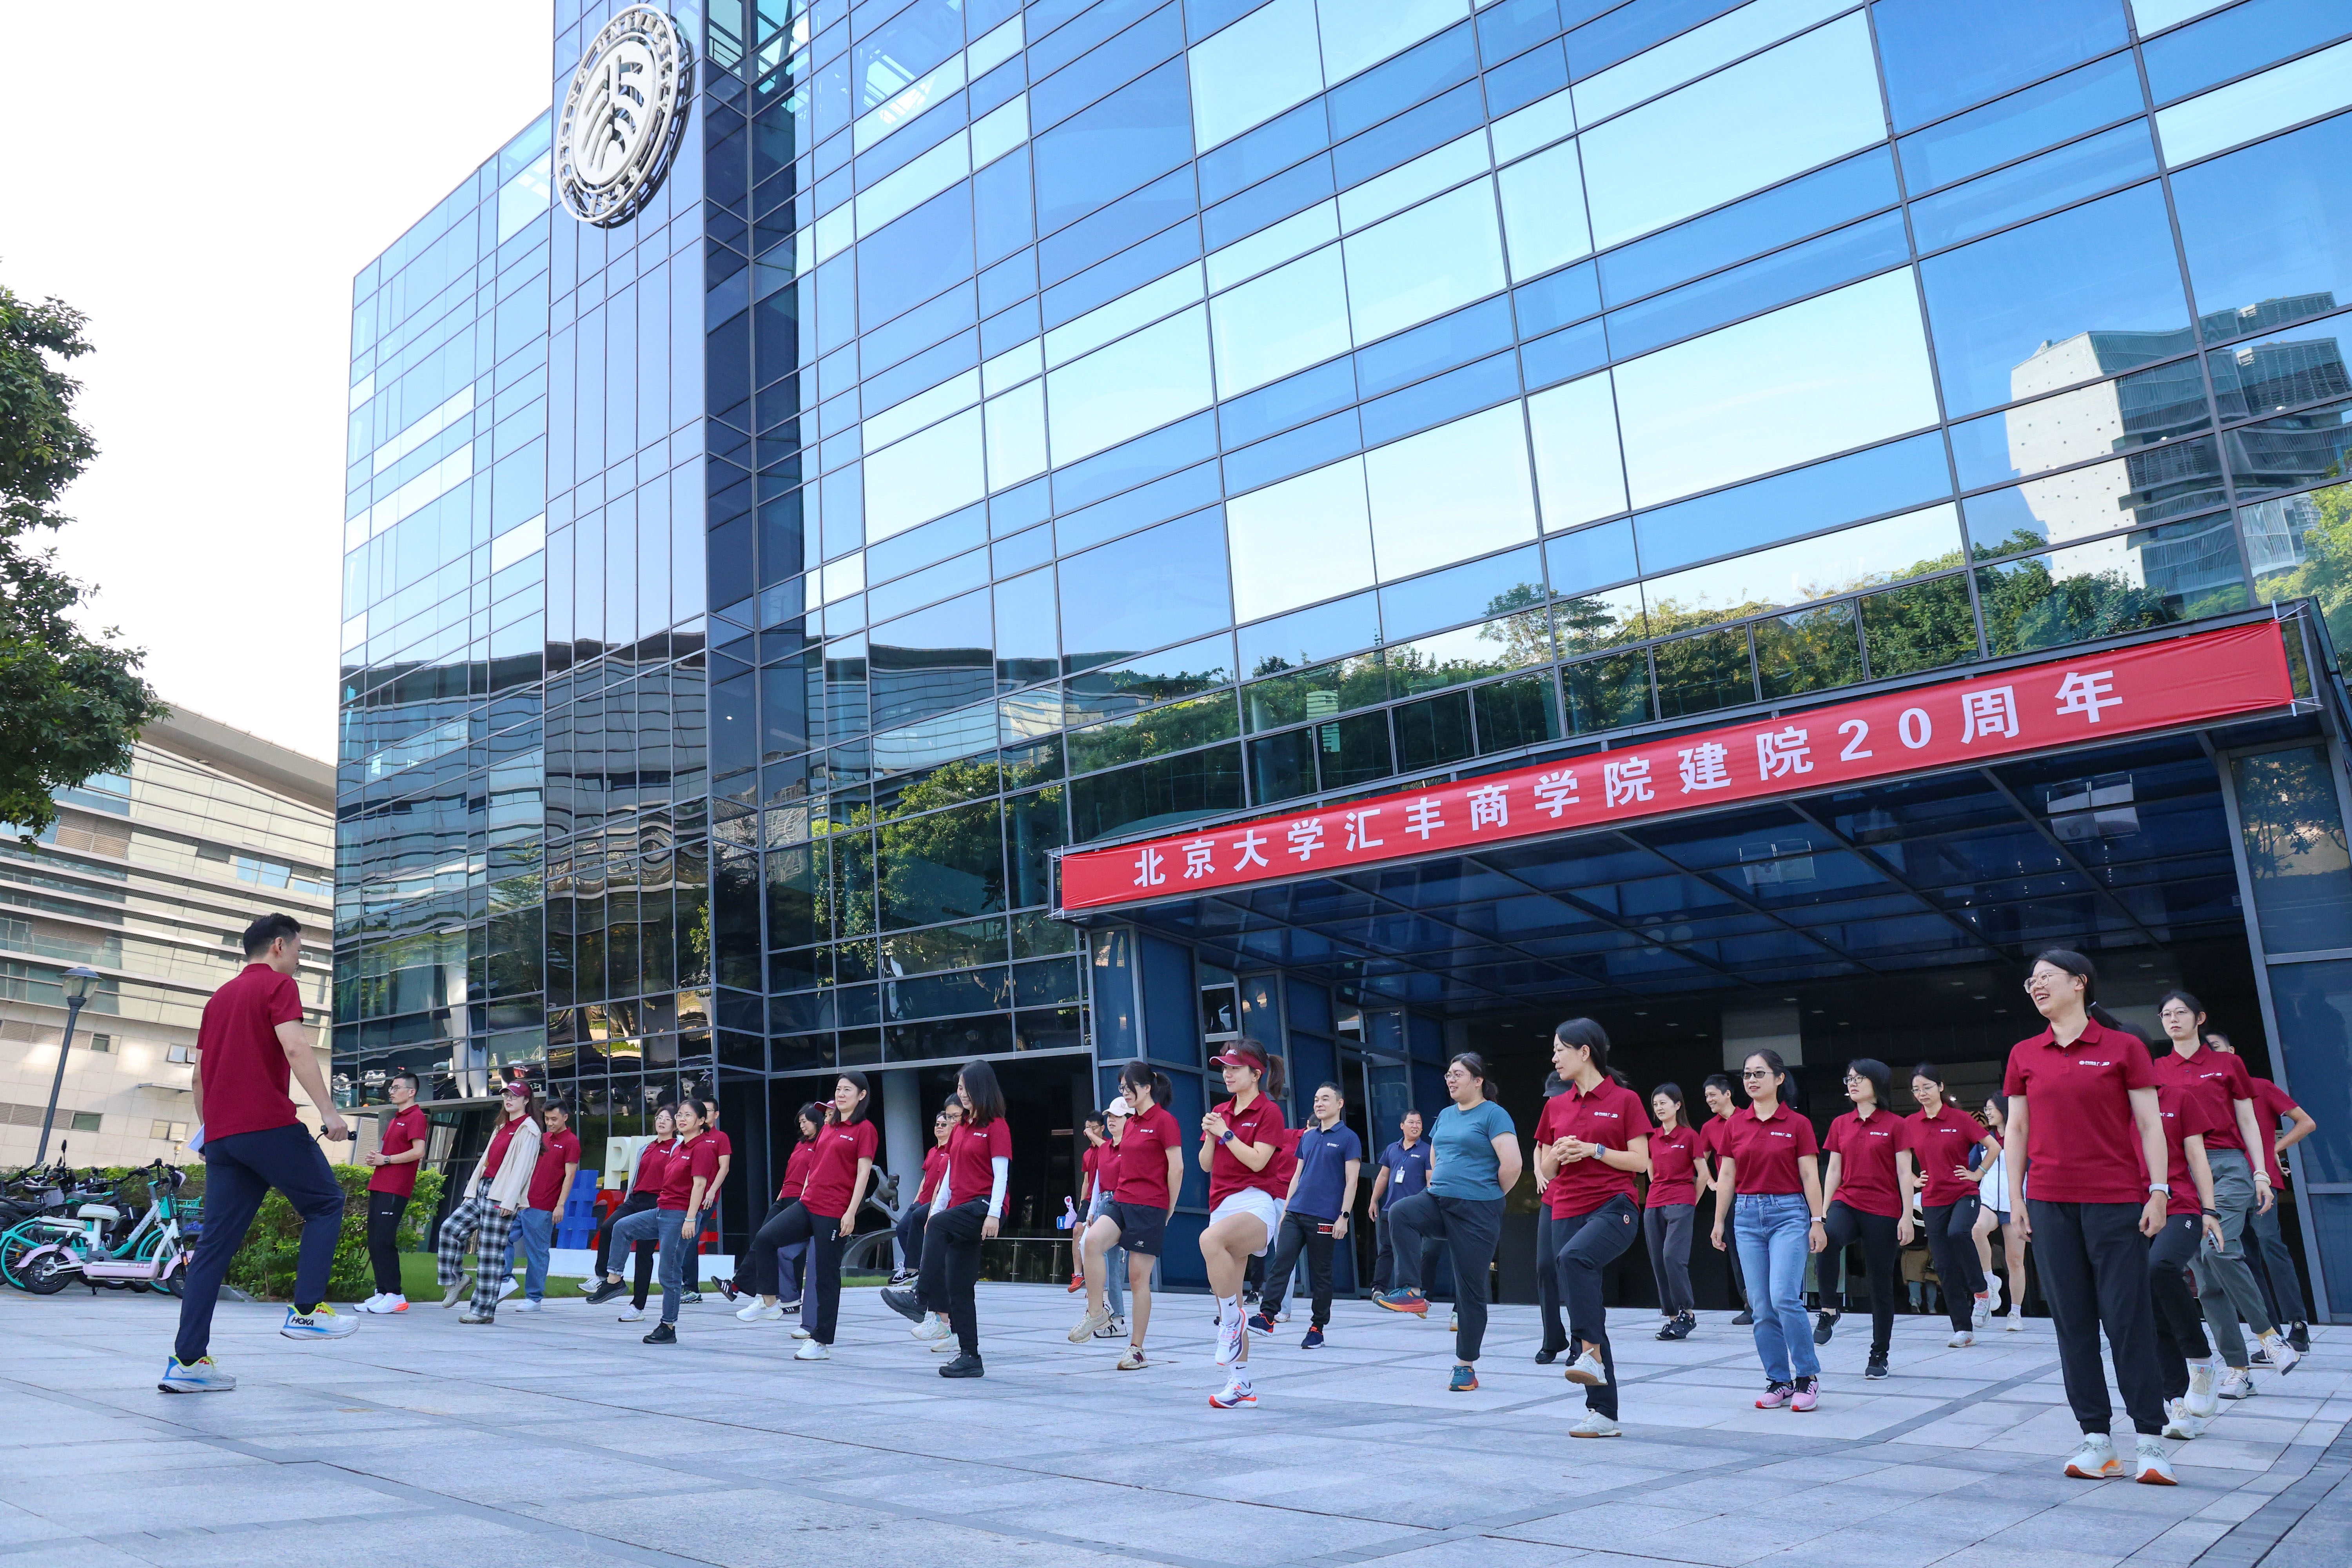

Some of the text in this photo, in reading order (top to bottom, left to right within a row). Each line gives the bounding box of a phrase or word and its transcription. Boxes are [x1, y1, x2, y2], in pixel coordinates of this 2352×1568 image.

[595, 11, 673, 114] UNIVERSITY
[559, 67, 589, 190] PEKING
[588, 165, 641, 215] 1898
[1133, 670, 2123, 887] 北京大学汇丰商学院建院20周年
[291, 1316, 314, 1326] HOKA
